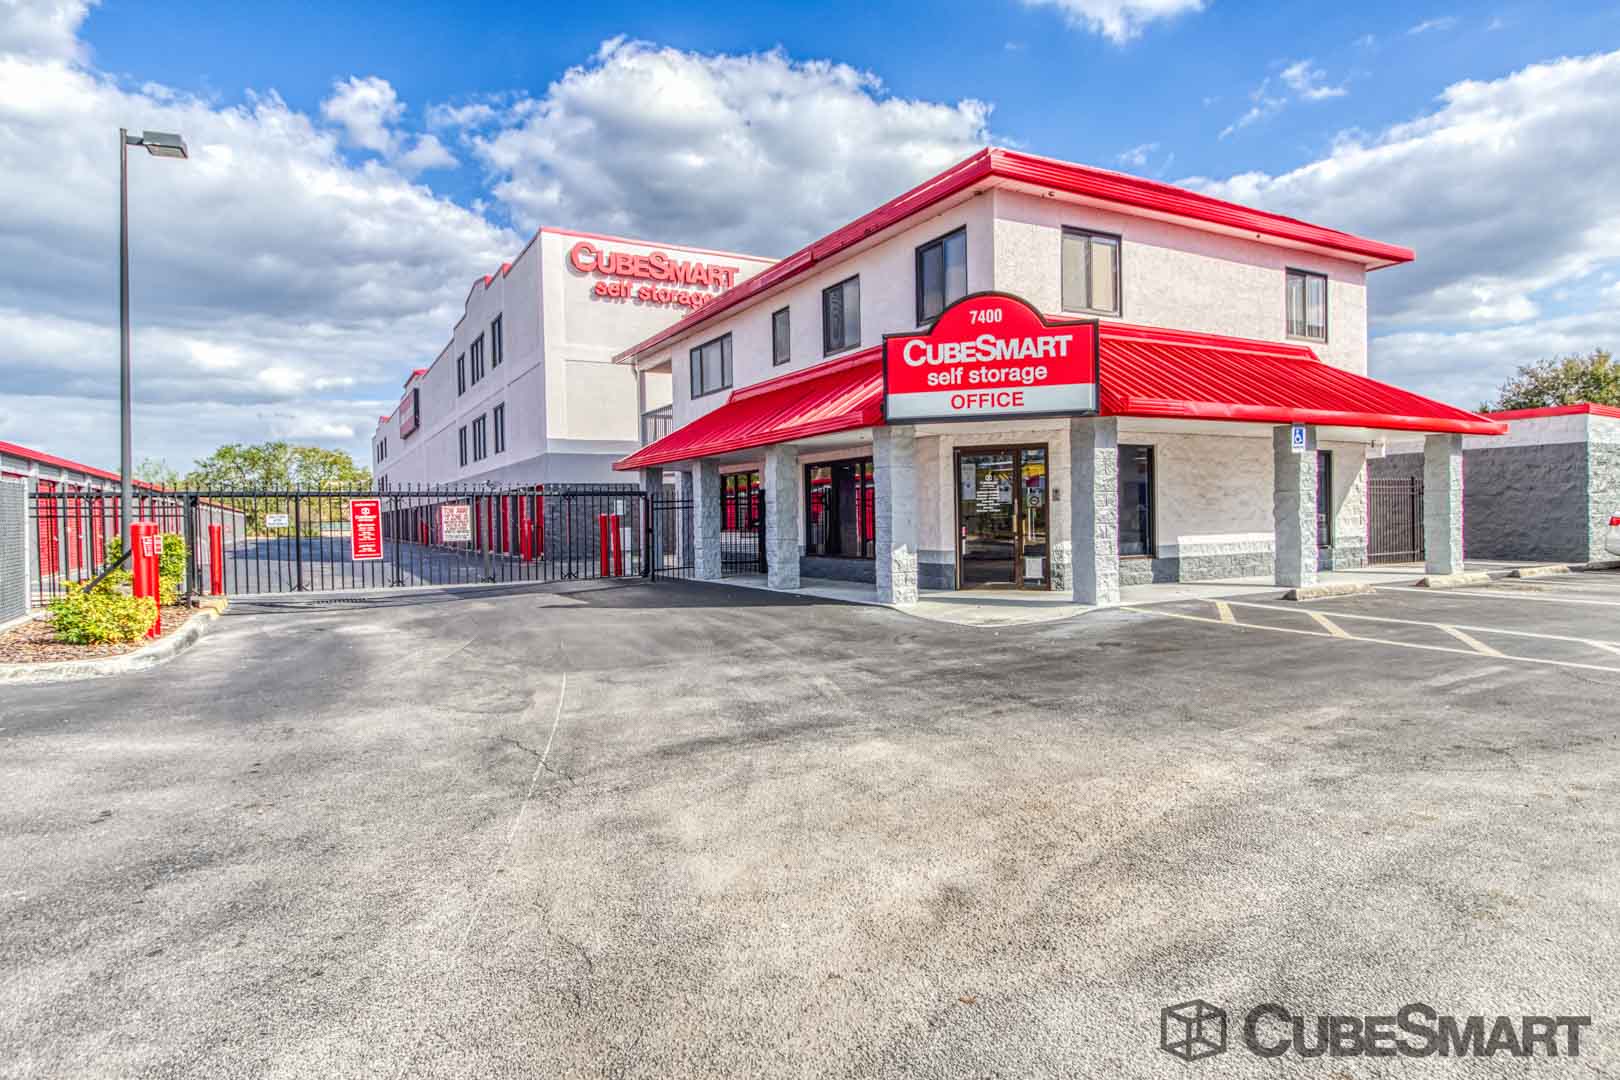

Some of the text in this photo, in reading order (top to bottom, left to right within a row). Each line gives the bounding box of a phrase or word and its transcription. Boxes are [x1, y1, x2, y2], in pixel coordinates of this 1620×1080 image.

[595, 280, 633, 297] self
[969, 309, 1002, 324] 7400
[927, 365, 1048, 386] self storage
[951, 391, 1024, 409] OFFICE
